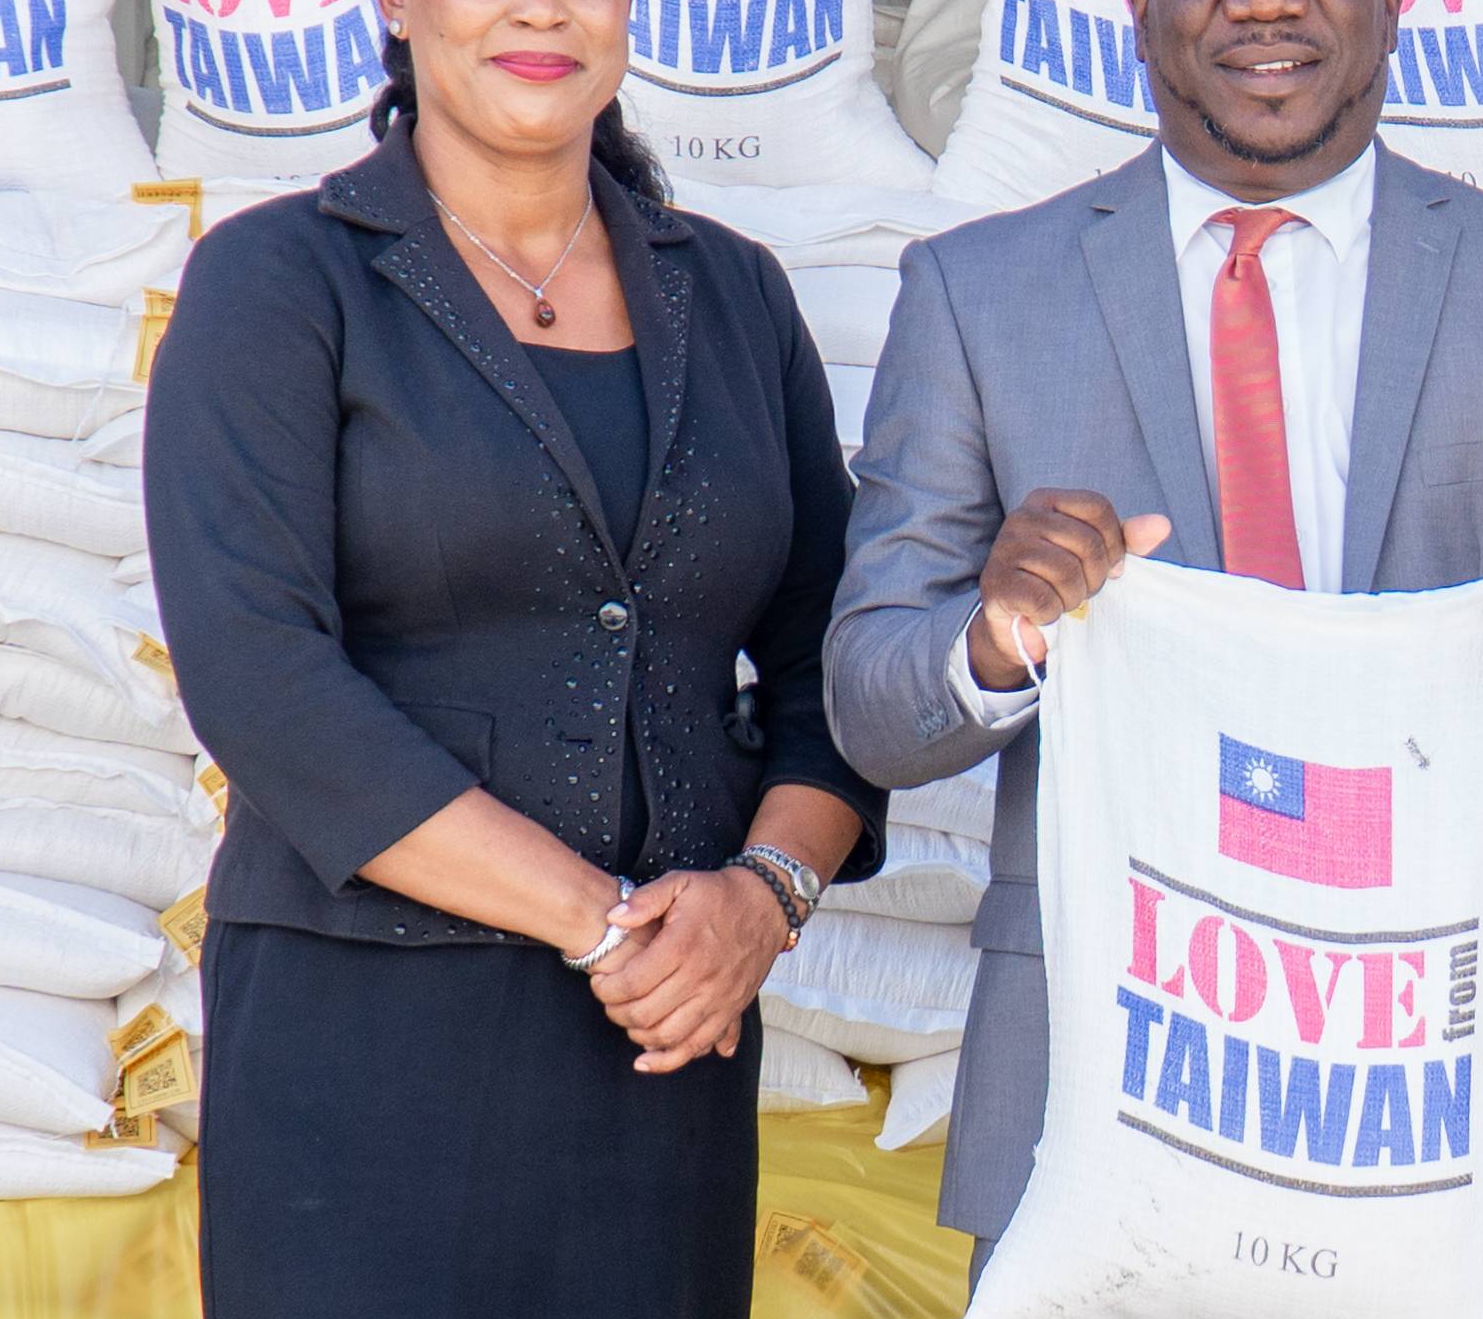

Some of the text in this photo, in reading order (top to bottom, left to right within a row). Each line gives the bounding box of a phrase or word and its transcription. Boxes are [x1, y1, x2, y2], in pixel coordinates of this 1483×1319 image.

[674, 135, 761, 160] 10 KG
[1127, 877, 1426, 1049] LOVE
[1443, 940, 1480, 1043] from
[1117, 984, 1473, 1166] TAIWAN
[1231, 1230, 1339, 1280] 10 KG
